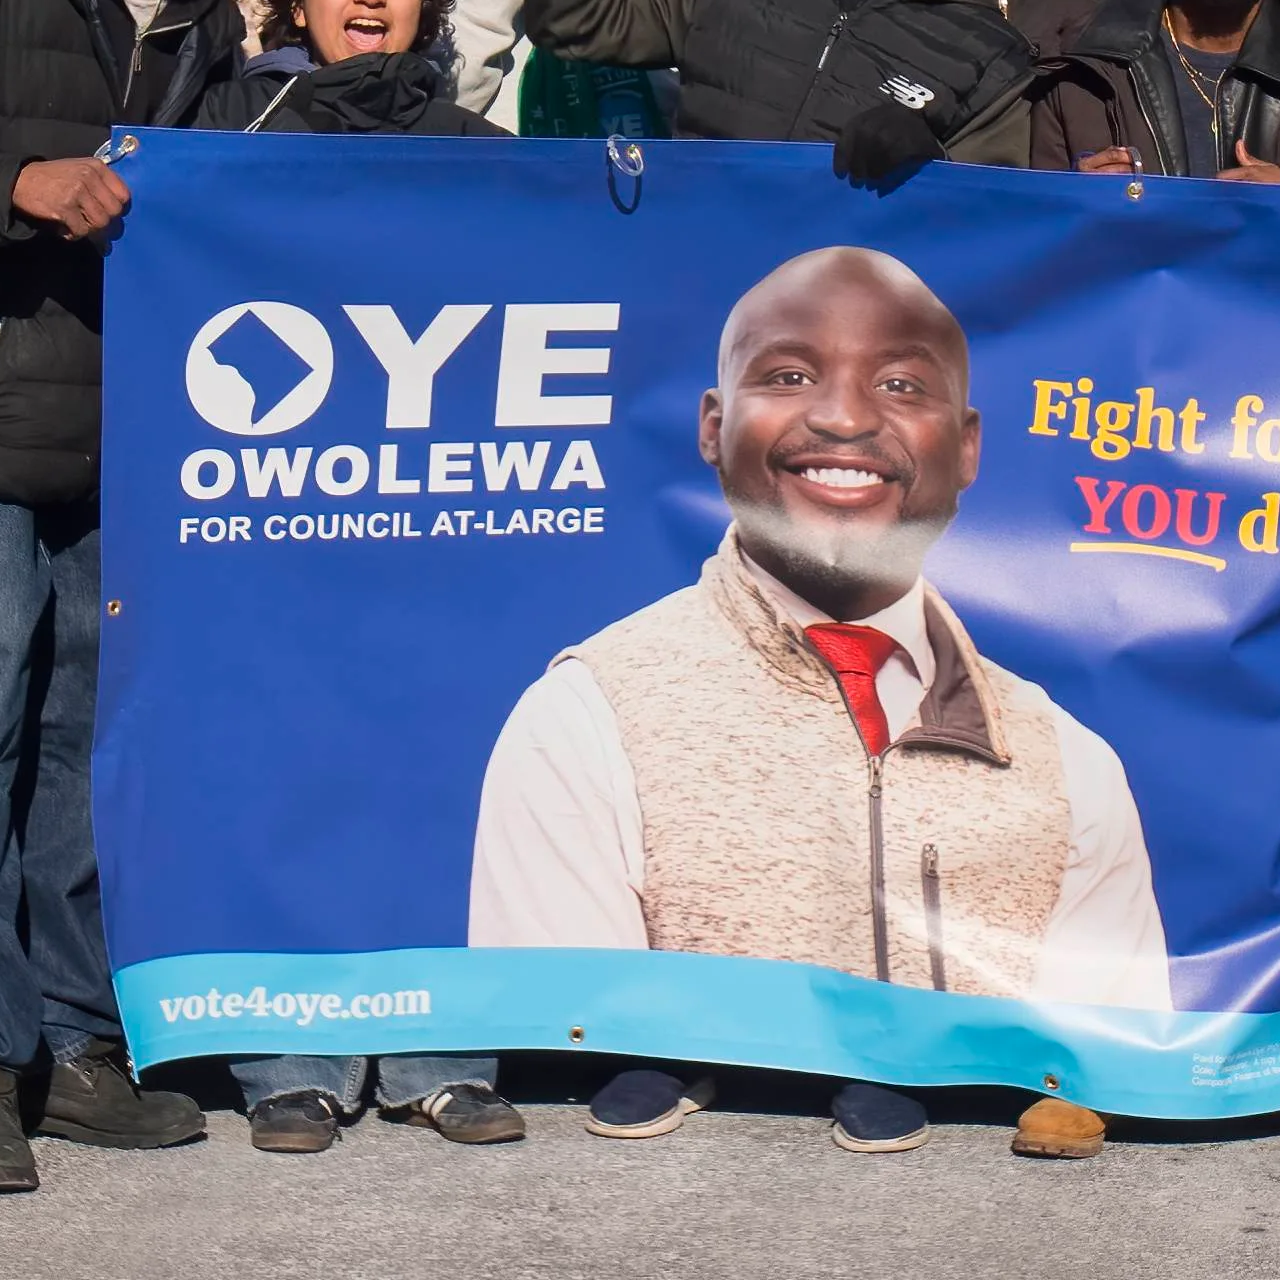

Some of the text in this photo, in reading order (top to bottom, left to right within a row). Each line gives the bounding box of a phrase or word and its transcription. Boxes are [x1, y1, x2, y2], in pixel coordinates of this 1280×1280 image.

[186, 301, 620, 436] OYE
[1028, 377, 1206, 461] Fight
[181, 440, 606, 500] OWOLEWA
[179, 507, 604, 544] FOR COUNCIL AT-LARGE
[1074, 476, 1227, 546] YOU
[160, 986, 431, 1026] vote4oye.com
